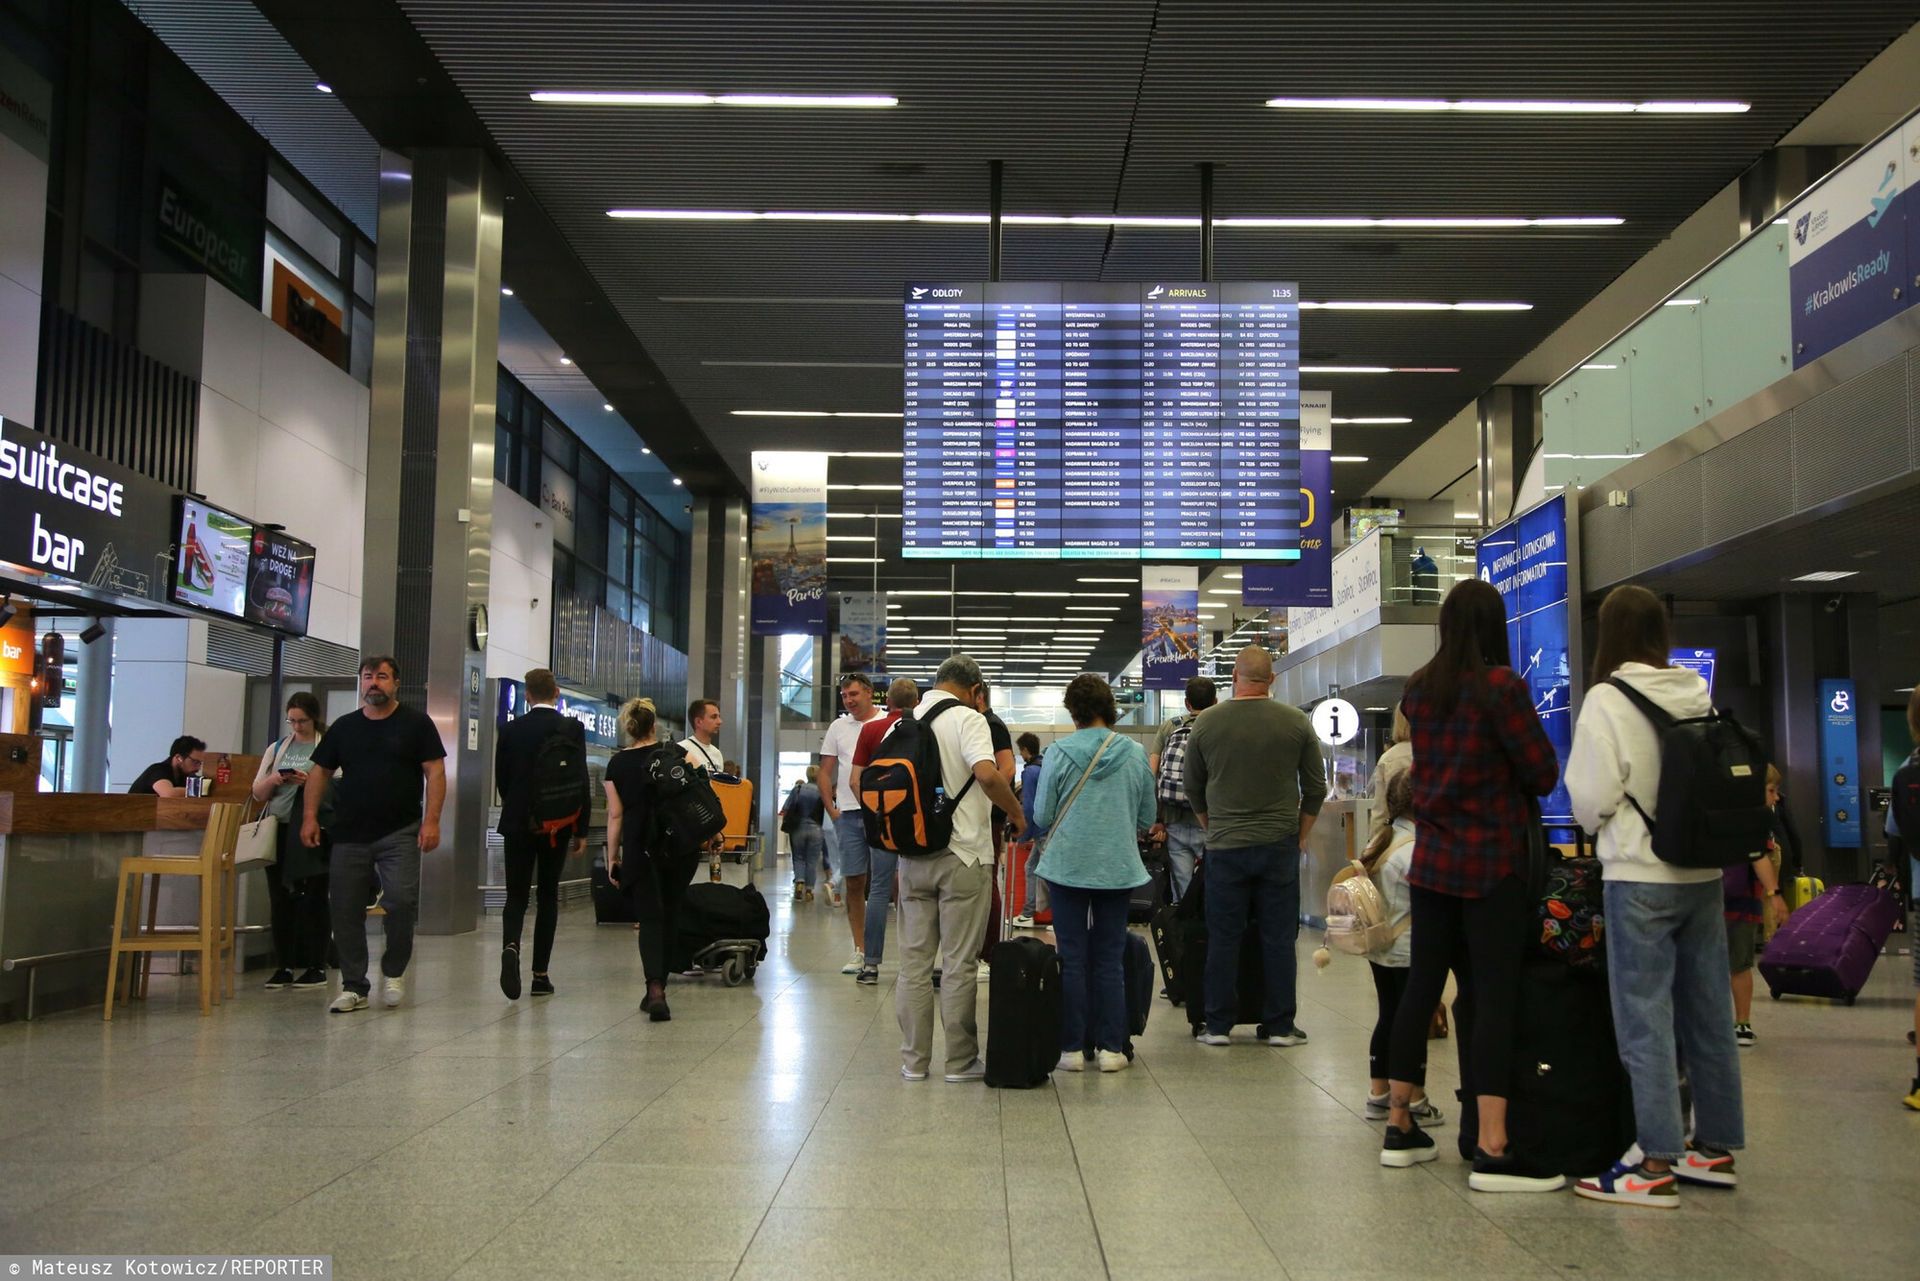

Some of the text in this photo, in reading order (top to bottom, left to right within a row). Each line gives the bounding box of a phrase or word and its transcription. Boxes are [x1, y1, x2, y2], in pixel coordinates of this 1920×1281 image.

[160, 186, 249, 278] Europcar
[1804, 249, 1890, 316] #KrakowIsReady
[932, 288, 963, 298] ODLOTY
[1168, 288, 1207, 298] ARRIVALS
[1272, 289, 1292, 298] 11:35
[0, 440, 124, 518] suitcase
[759, 486, 821, 495] #FlyWithConfidence
[31, 513, 85, 573] bar
[271, 542, 287, 560] WEŹ
[1492, 530, 1556, 575] INFORMACJA LOTNISKOWA
[786, 587, 823, 607] Paris
[3, 640, 22, 660] bar
[1146, 648, 1197, 668] Frankfurt
